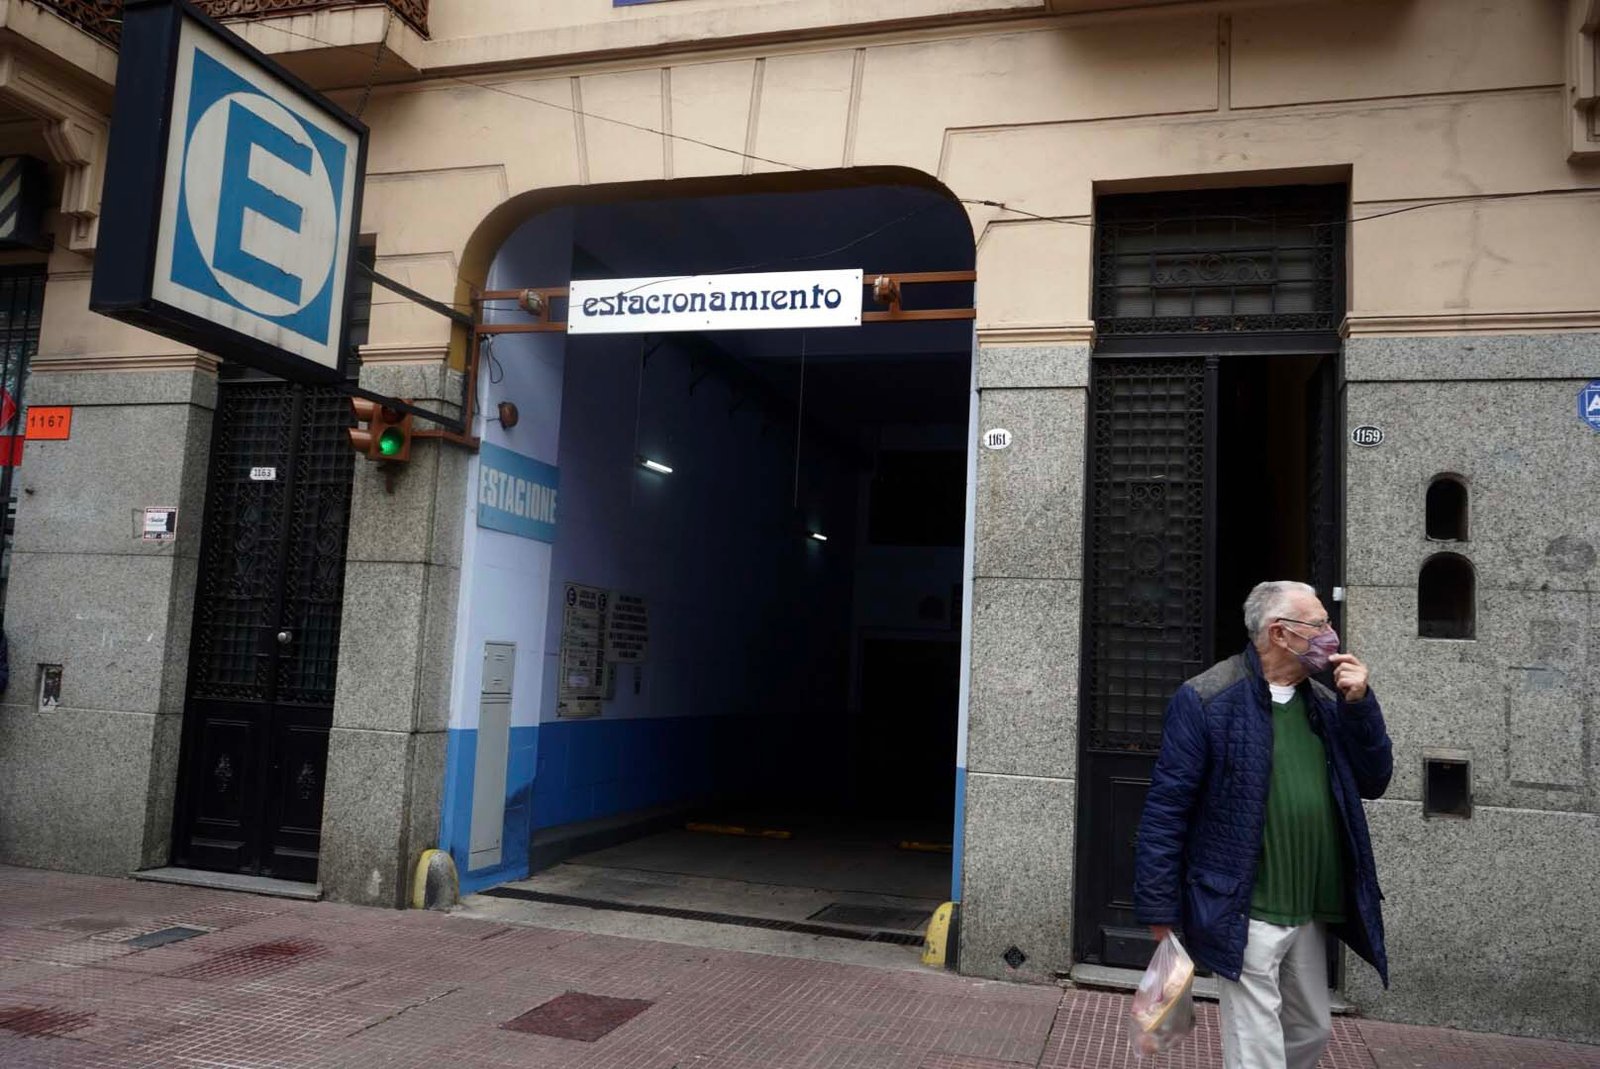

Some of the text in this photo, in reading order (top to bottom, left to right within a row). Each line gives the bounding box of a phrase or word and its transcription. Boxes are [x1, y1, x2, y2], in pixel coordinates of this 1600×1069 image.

[212, 99, 313, 306] E
[582, 284, 842, 316] estacionamiento
[30, 415, 64, 428] 1167
[988, 433, 1006, 446] 1161
[1356, 429, 1380, 442] 1159
[479, 464, 557, 524] ESTACIONE
